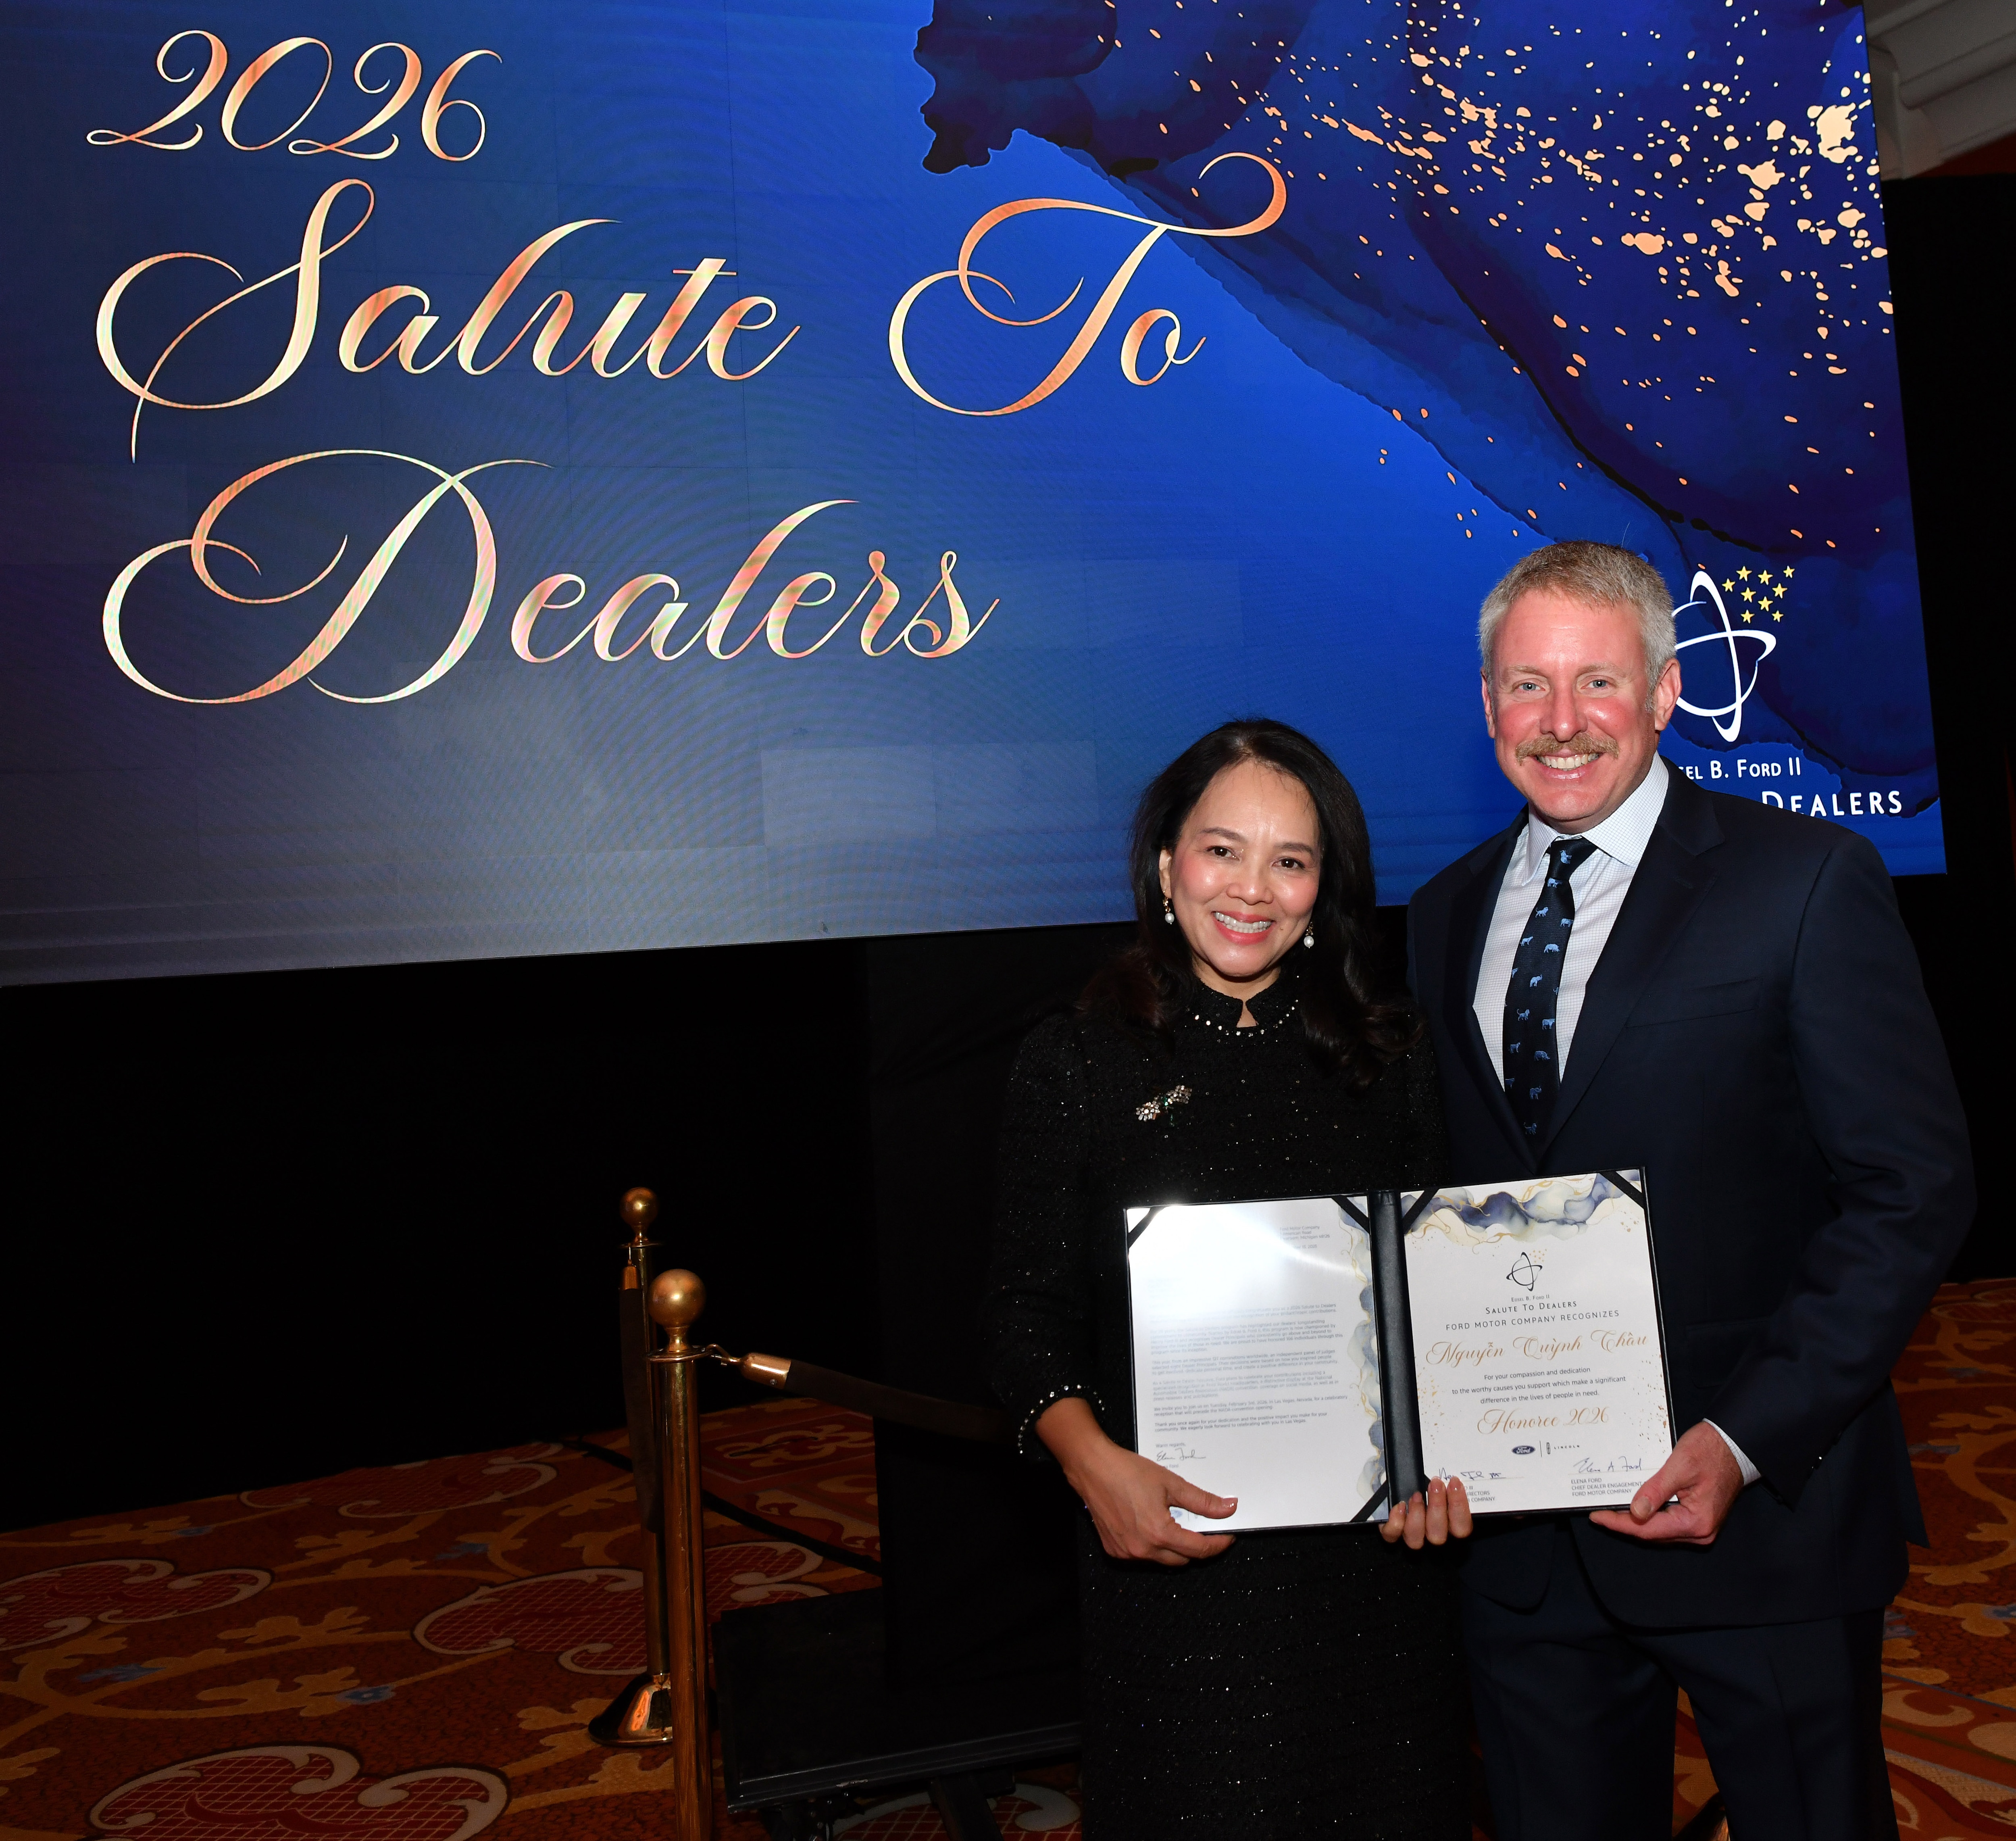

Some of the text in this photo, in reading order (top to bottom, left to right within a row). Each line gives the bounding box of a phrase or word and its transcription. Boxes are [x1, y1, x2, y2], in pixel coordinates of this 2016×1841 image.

[87, 30, 502, 161] 2026
[96, 152, 1286, 463] Salute To
[102, 450, 1000, 704] Dealers
[1710, 760, 1729, 779] B.
[1789, 757, 1801, 776] II
[1446, 1310, 1619, 1330] FORD MOTOR COMPANY RECOGNIZES
[1510, 1370, 1544, 1378] compassion
[1595, 1376, 1626, 1384] significant
[1477, 1407, 1610, 1434] Honoree 2026
